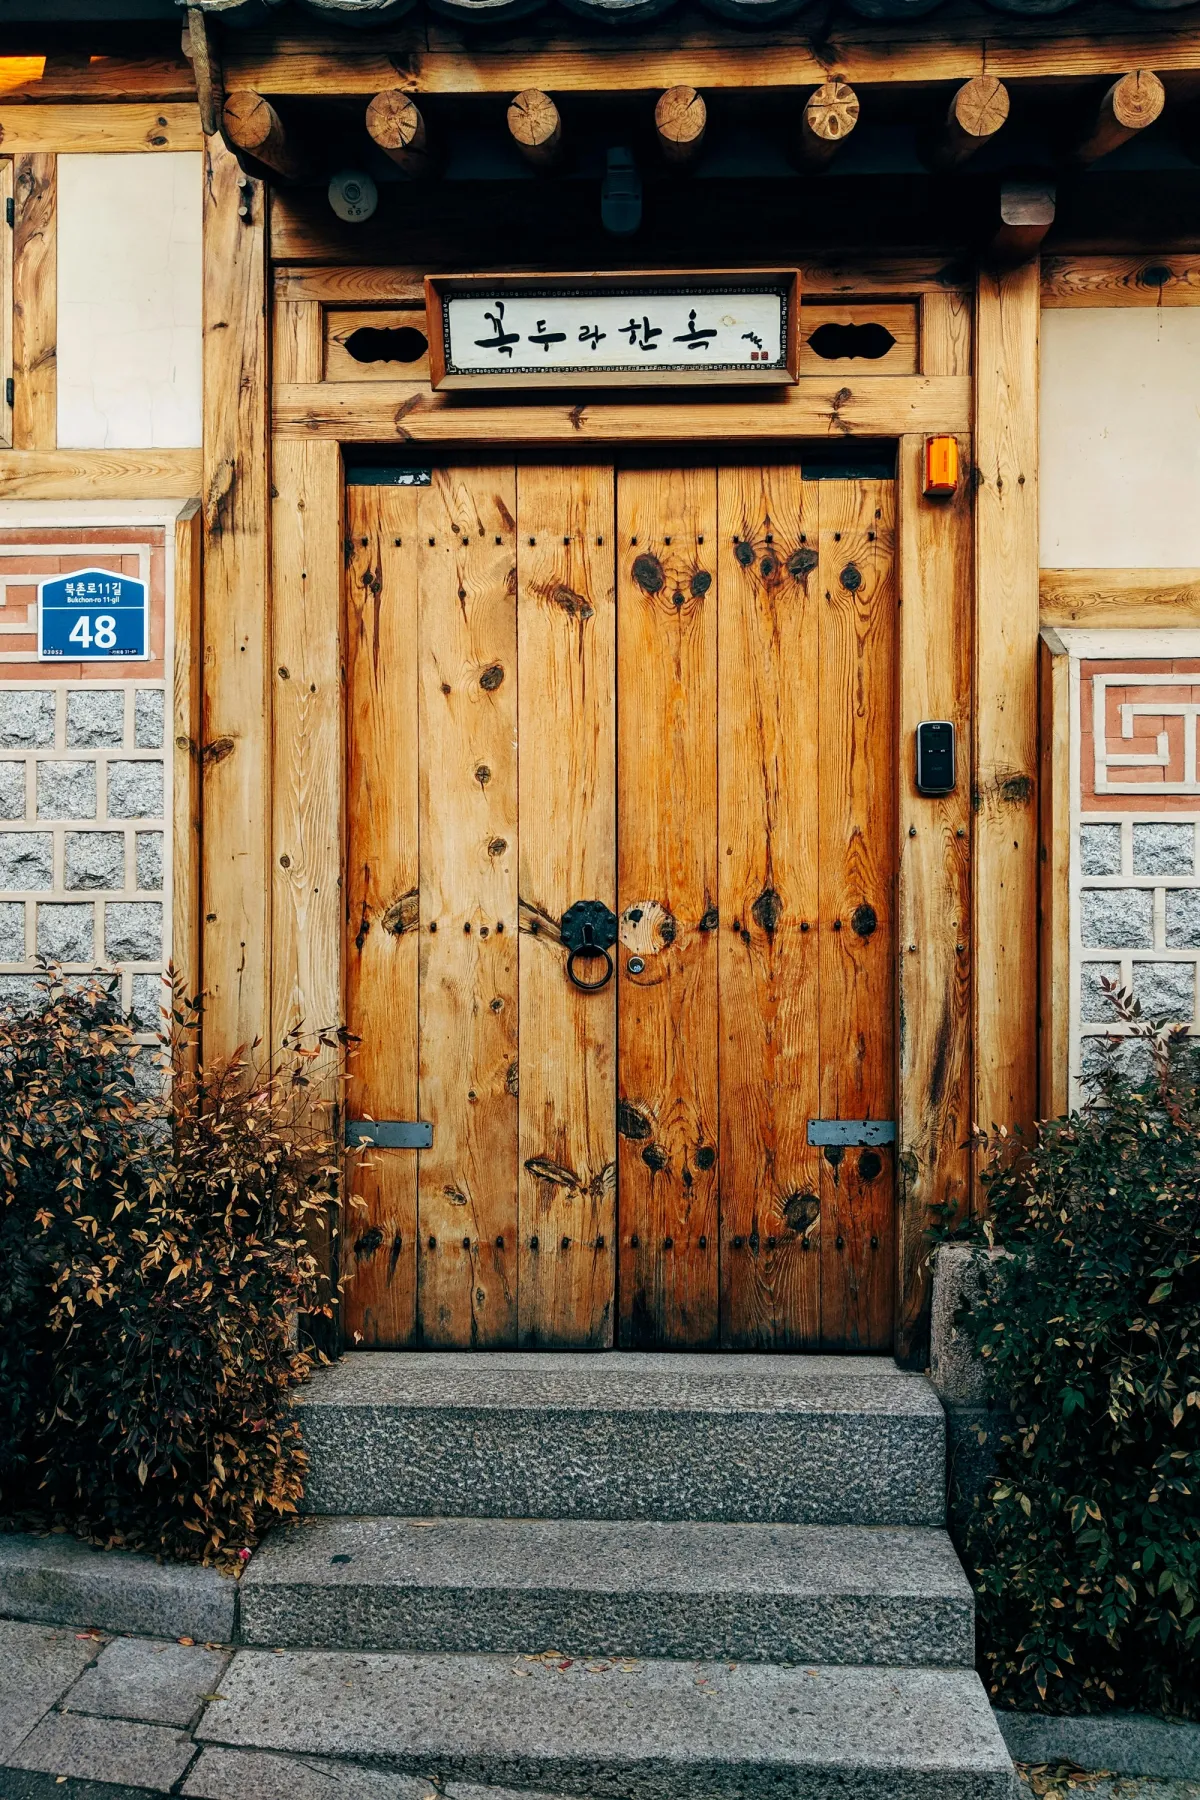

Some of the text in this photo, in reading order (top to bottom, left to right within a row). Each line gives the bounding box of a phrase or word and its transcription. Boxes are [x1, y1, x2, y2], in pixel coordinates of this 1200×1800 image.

[65, 582, 122, 596] 북촌로11길
[103, 596, 120, 604] 11-gil
[69, 615, 117, 649] 48
